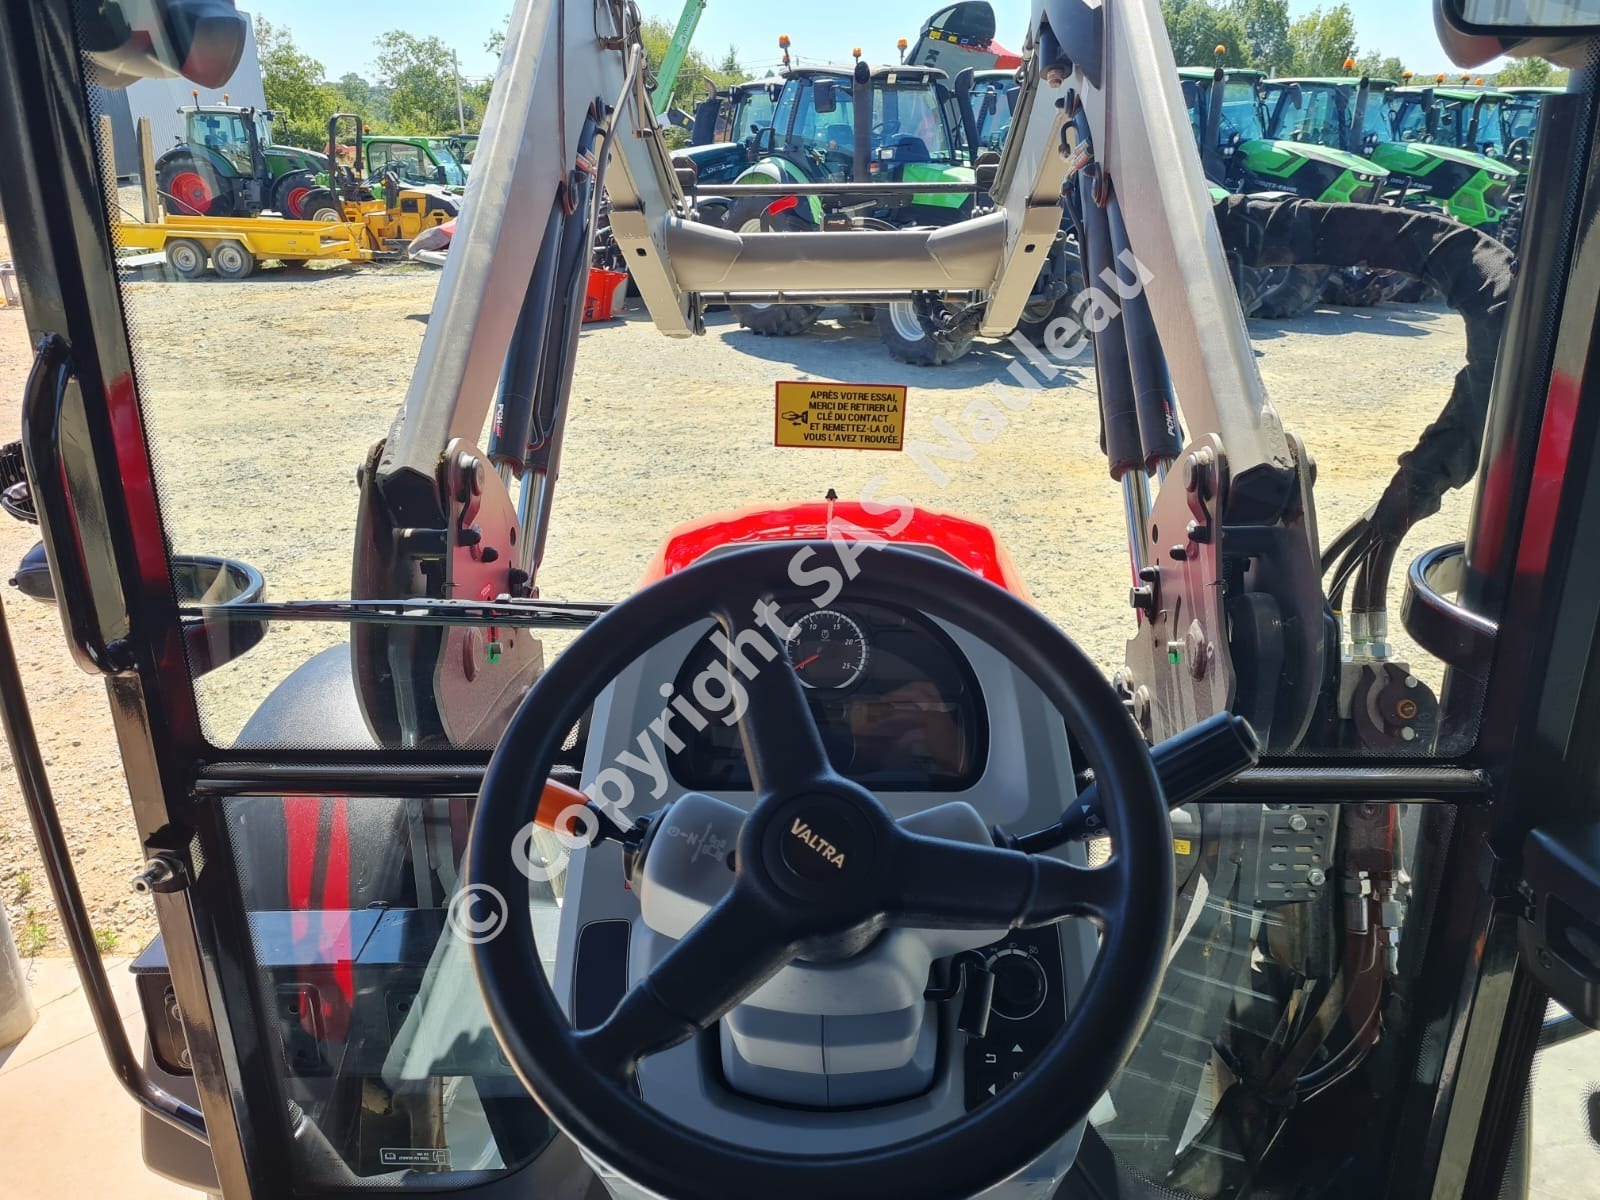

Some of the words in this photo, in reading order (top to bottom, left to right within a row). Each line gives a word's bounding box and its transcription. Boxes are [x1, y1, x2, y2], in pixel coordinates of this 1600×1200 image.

[810, 390, 839, 400] APRÈS
[840, 391, 869, 401] VOTRE
[870, 392, 898, 403] ESSAI,
[808, 401, 836, 411] MERCI
[837, 402, 849, 411] DE
[850, 403, 886, 412] RETIRER
[887, 404, 898, 413] LA
[816, 410, 833, 420] CLÉ
[834, 412, 846, 421] DU
[847, 413, 889, 423] CONTACT
[809, 422, 820, 431] ET
[822, 423, 880, 433] REMETTEZ-LA
[882, 423, 895, 433] OÙ
[803, 432, 827, 442] VOUS
[828, 433, 857, 443] L'AVEZ
[844, 638, 854, 646] 20
[841, 662, 851, 670] 25
[791, 817, 845, 869] VALTRA
